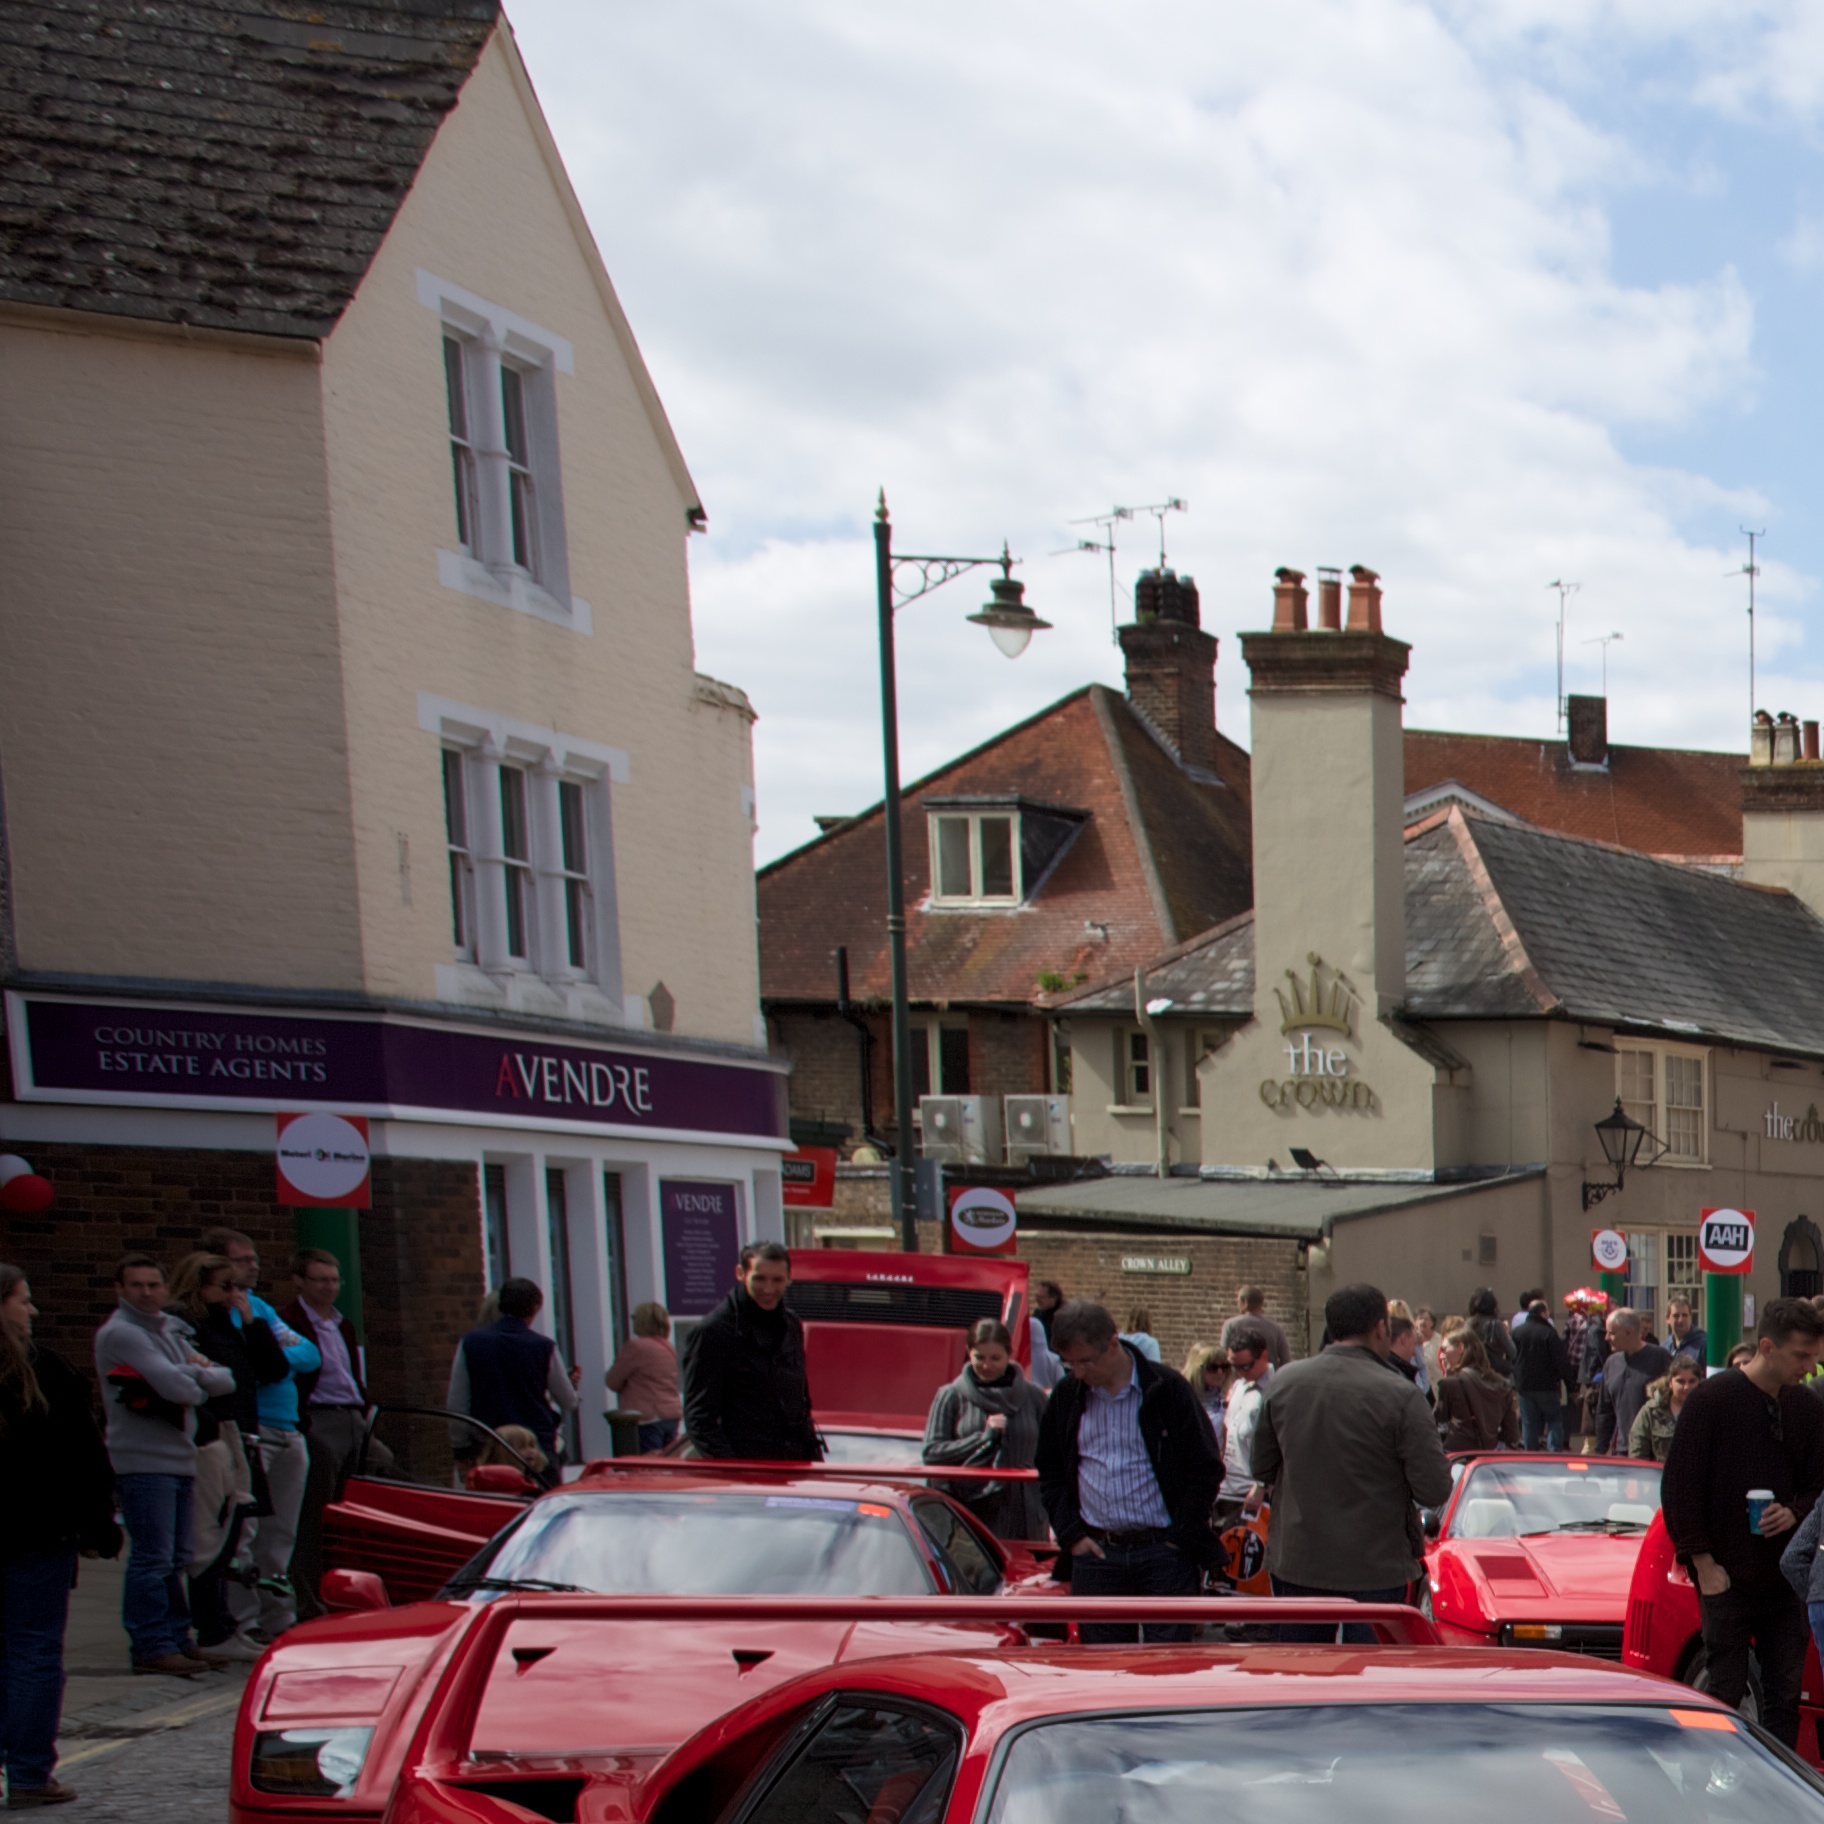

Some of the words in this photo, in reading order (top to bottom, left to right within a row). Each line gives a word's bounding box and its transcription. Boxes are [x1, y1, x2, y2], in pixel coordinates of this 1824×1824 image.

[95, 1026, 226, 1050] COUNTRY
[235, 1034, 327, 1056] HOMES
[1283, 1032, 1346, 1077] the
[99, 1051, 201, 1076] ESTATE
[209, 1058, 327, 1082] AGENTS
[1260, 1078, 1376, 1110] crown
[1709, 1225, 1744, 1247] AAH
[1122, 1257, 1154, 1270] CROWN
[1158, 1258, 1187, 1271] ALLEY
